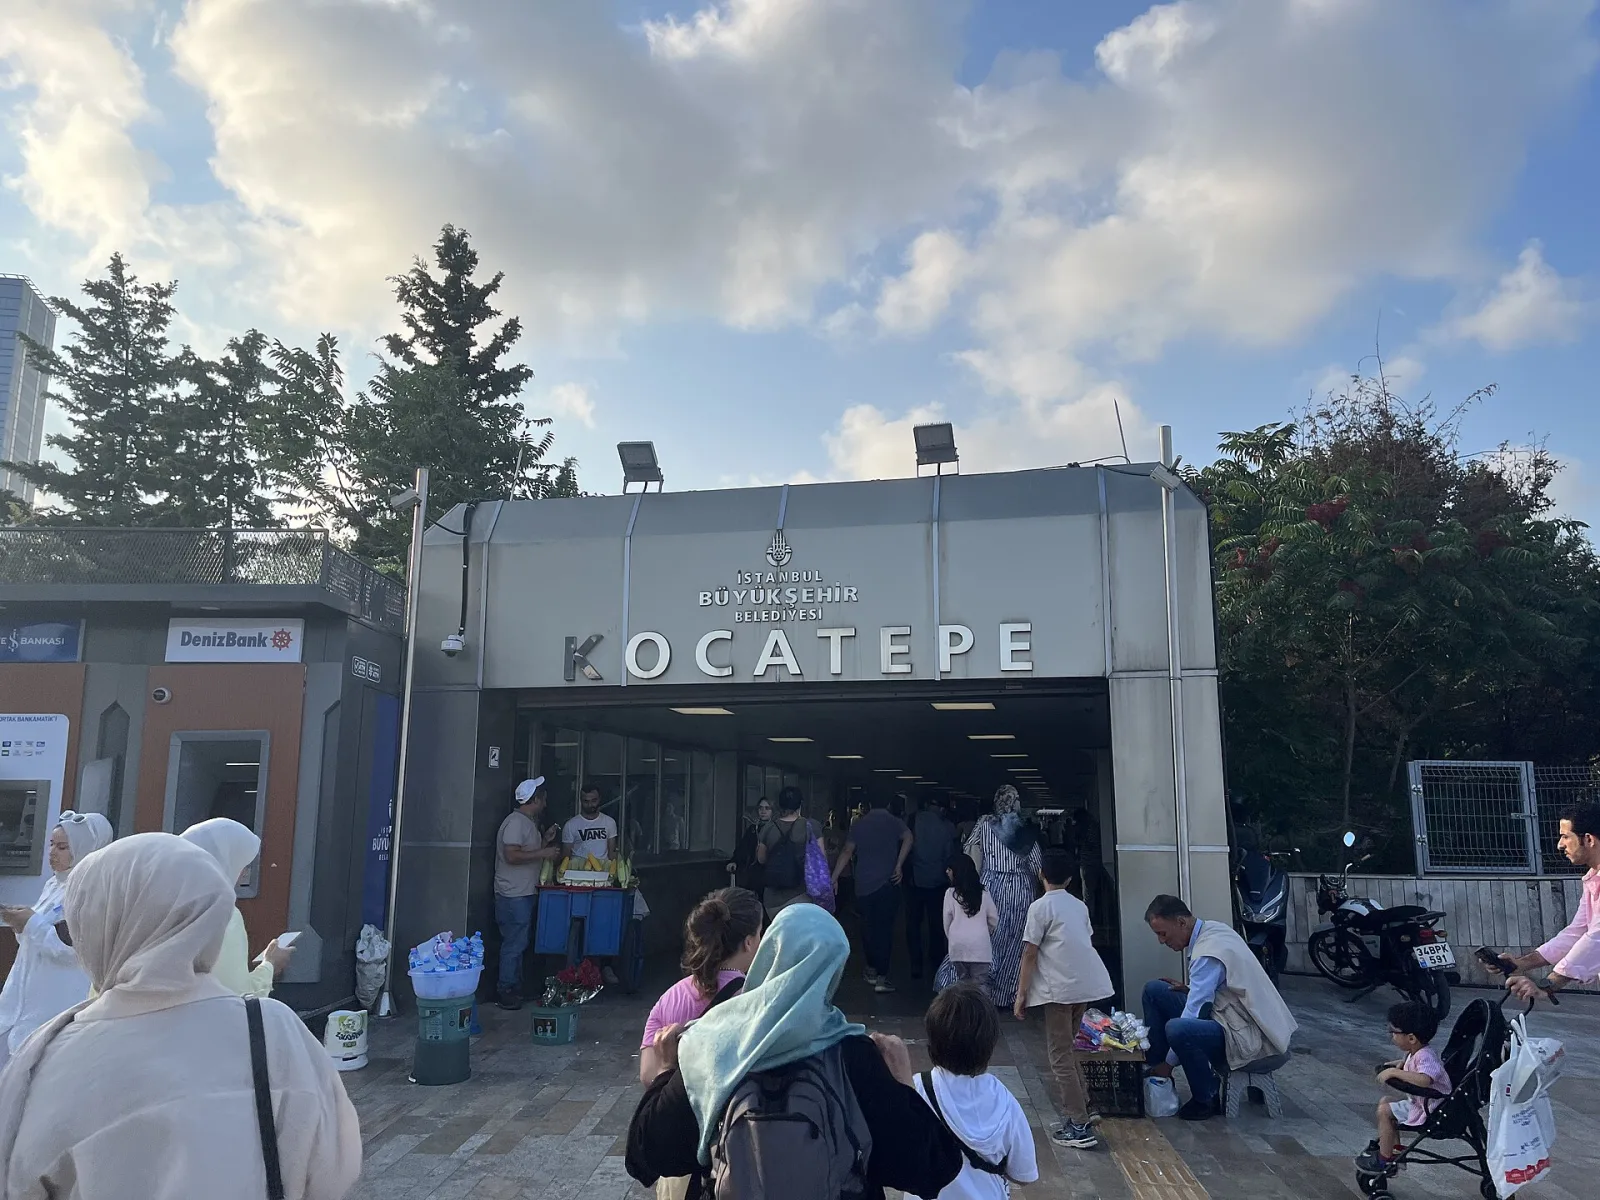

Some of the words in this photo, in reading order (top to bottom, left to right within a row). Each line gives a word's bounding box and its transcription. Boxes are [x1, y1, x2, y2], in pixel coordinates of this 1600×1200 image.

[737, 570, 823, 585] İSTANBUL
[699, 582, 859, 608] BÜYÜKŞEHİR
[735, 607, 823, 622] BELEDİYESİ
[20, 637, 65, 645] BANKASI
[180, 631, 268, 648] DenizBank
[564, 622, 1033, 681] KOCATEPE
[577, 827, 607, 841] VANS
[1429, 954, 1447, 964] 591
